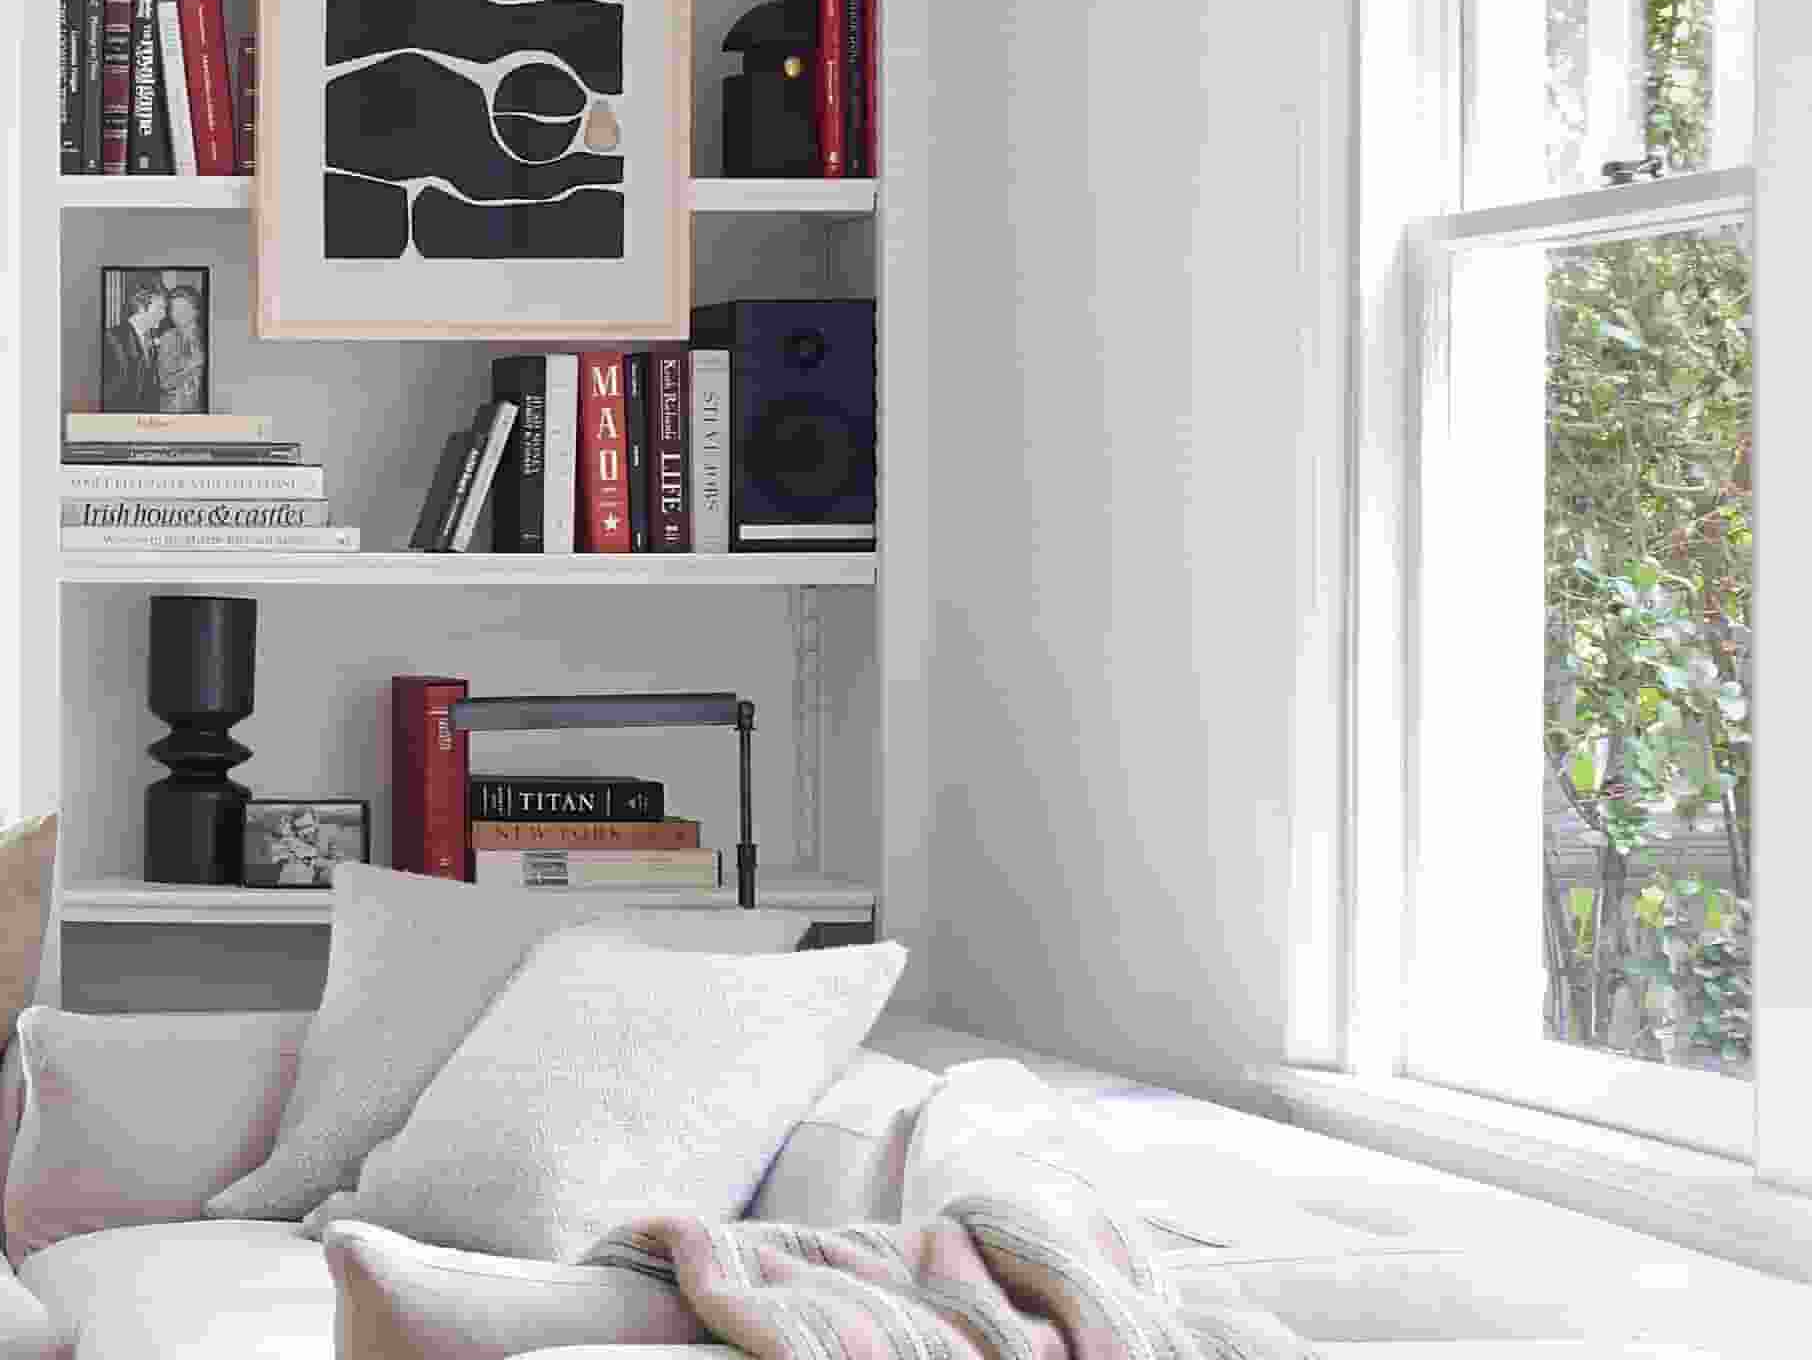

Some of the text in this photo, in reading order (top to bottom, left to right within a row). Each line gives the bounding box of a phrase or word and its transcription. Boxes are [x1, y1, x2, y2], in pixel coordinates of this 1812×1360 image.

[591, 365, 623, 480] MAO
[662, 451, 680, 512] LIFE
[80, 503, 130, 527] Irish
[133, 503, 206, 527] houses
[235, 503, 304, 527] castles
[519, 791, 595, 812] TITAN
